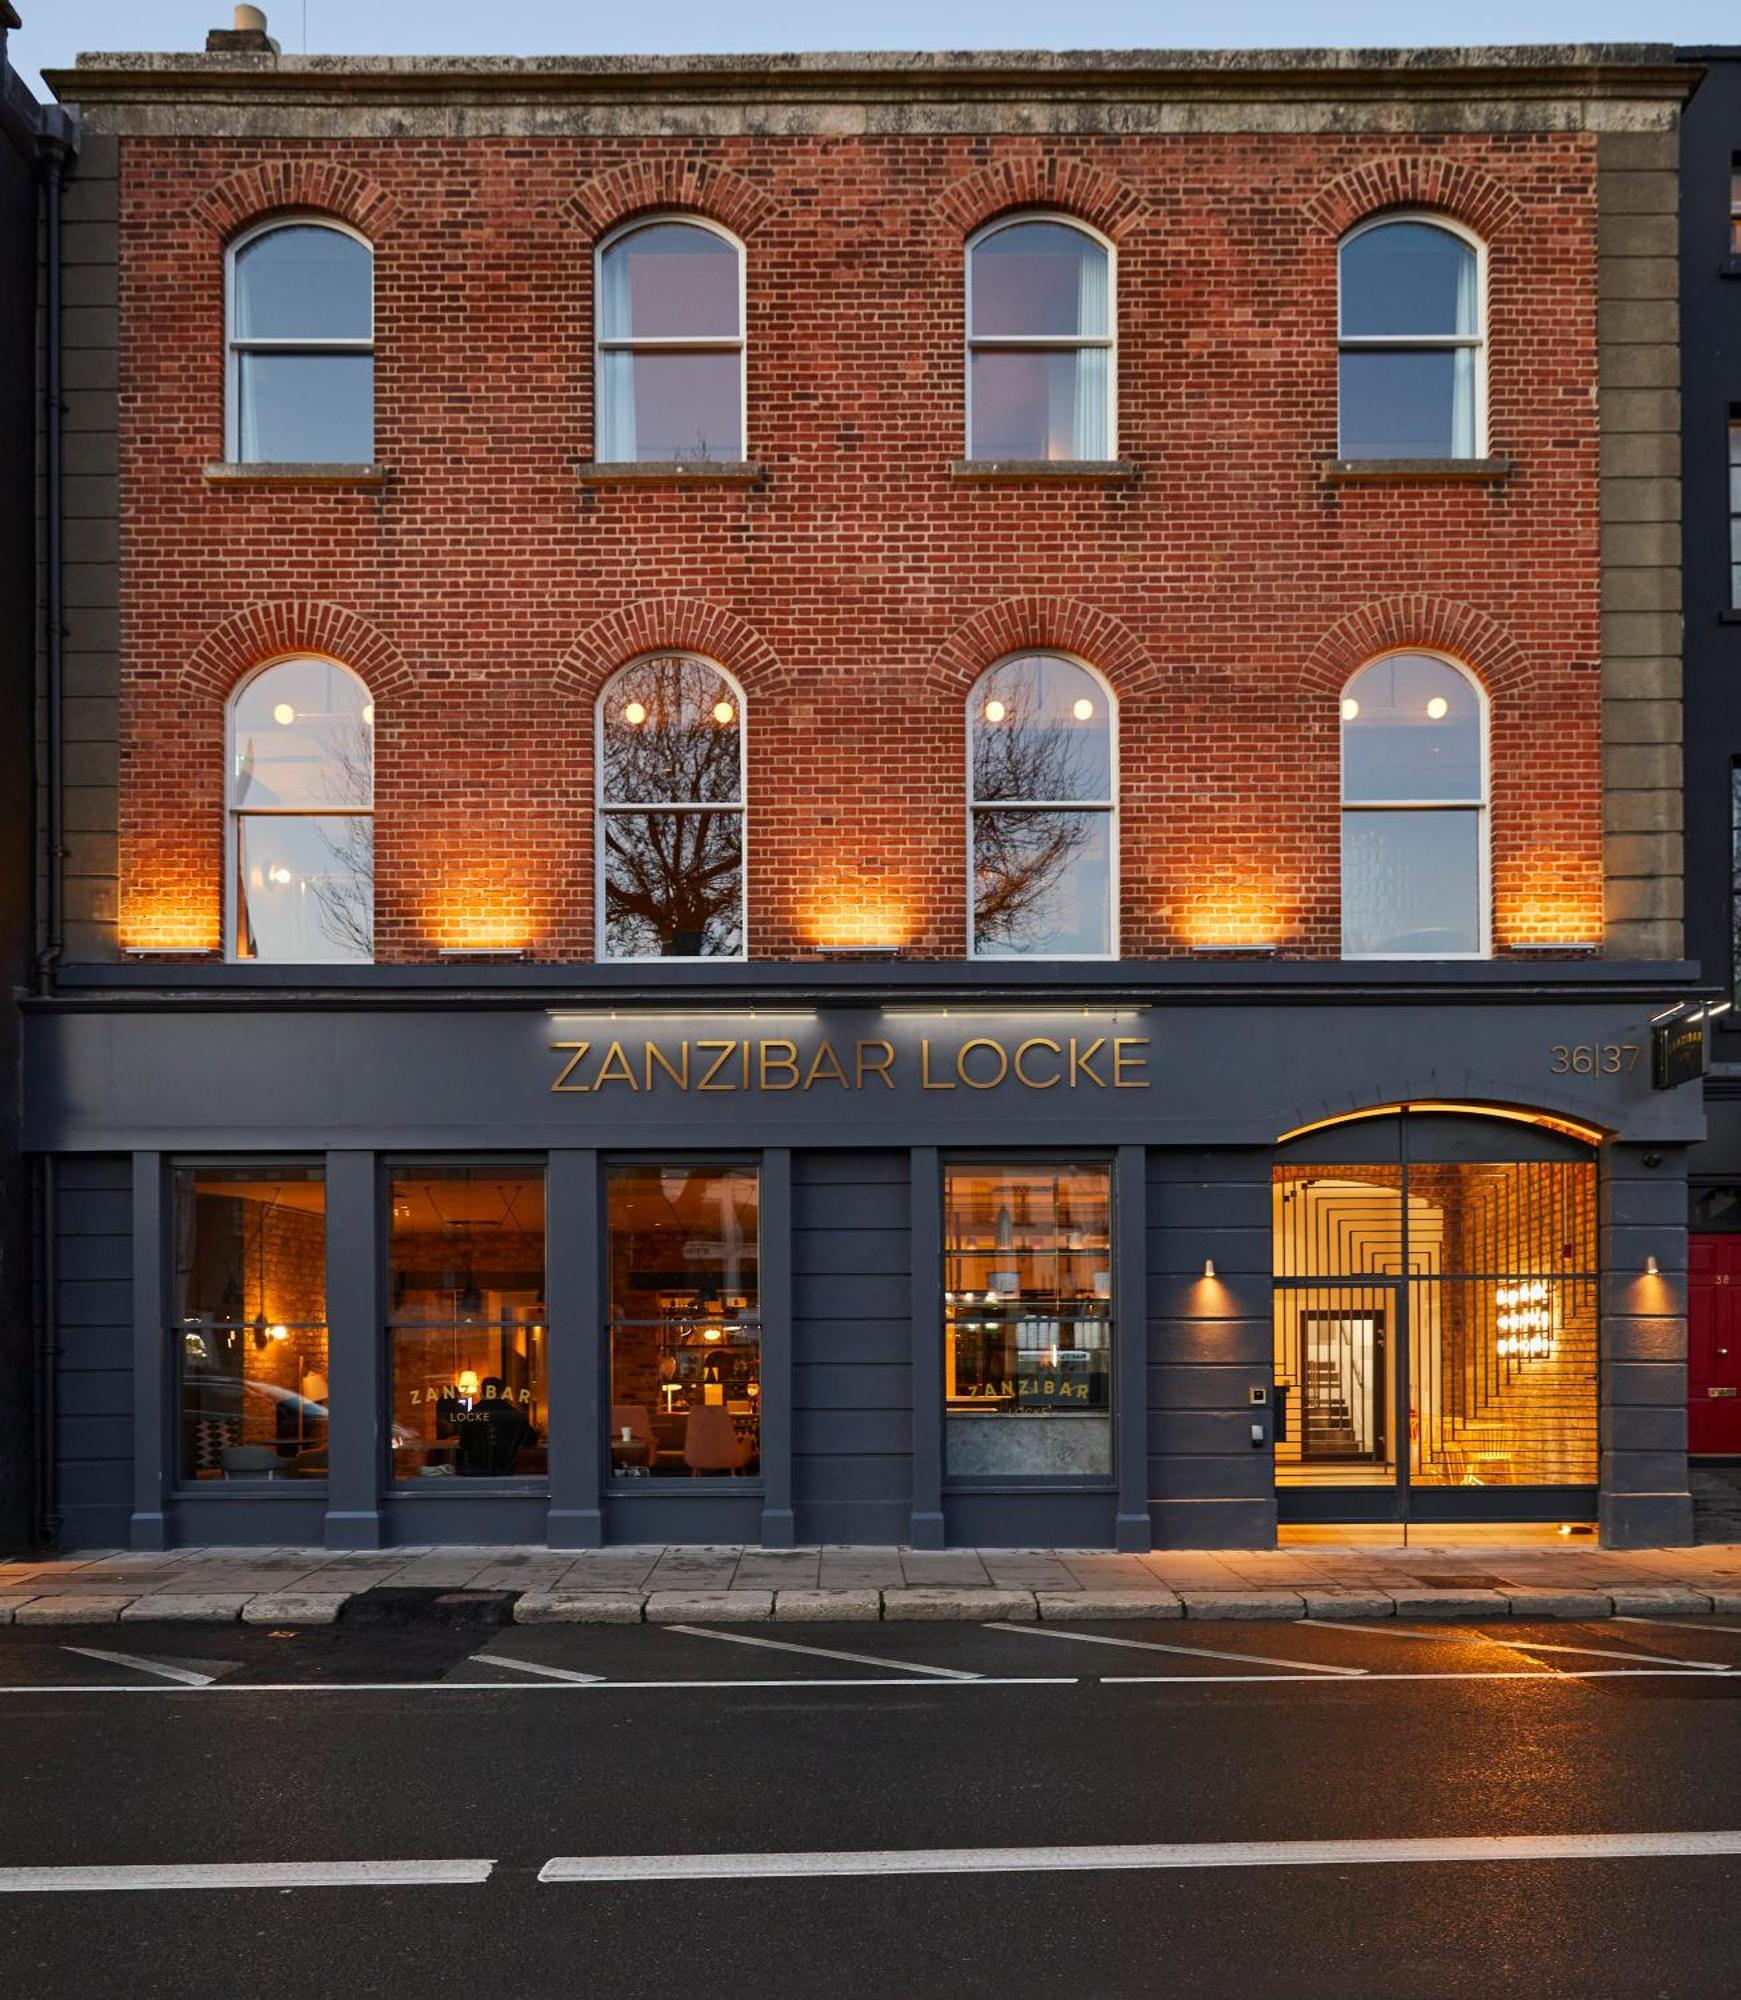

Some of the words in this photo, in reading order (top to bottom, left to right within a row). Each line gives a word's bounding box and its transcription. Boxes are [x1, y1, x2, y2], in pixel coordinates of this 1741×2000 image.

[549, 1040, 896, 1092] ZANZIBAR
[921, 1037, 1151, 1090] LOCKE
[410, 1384, 531, 1404] ZANZBAR
[968, 1380, 1089, 1399] ZANZIBAR
[450, 1412, 490, 1422] LOCKE
